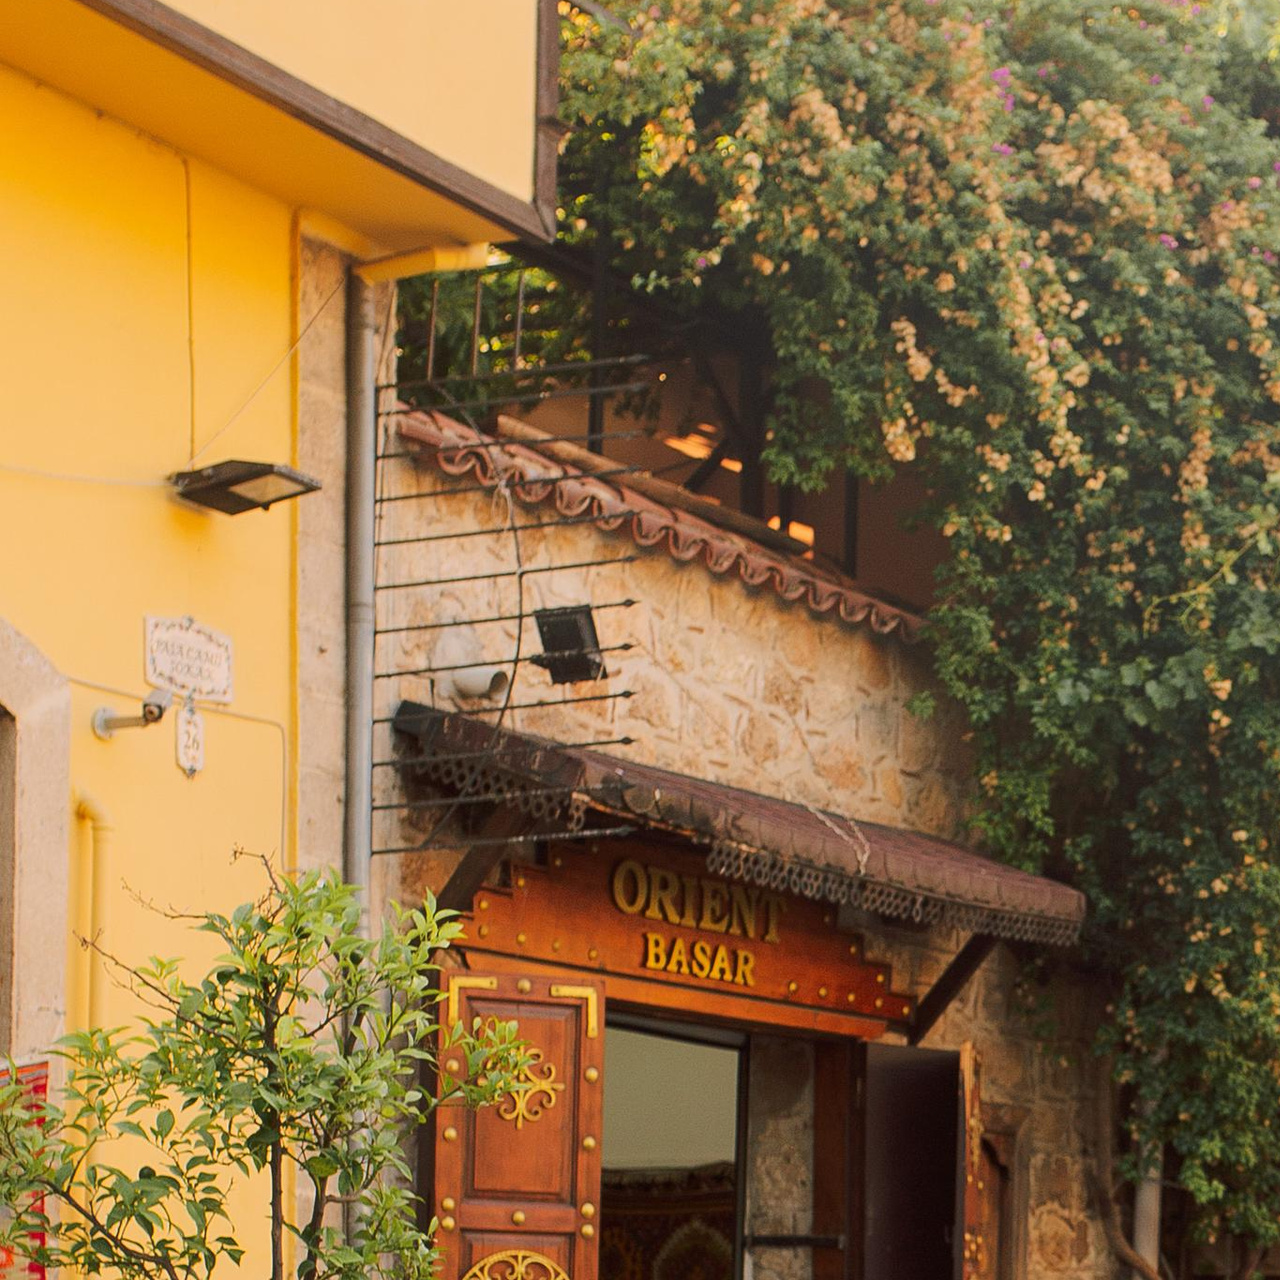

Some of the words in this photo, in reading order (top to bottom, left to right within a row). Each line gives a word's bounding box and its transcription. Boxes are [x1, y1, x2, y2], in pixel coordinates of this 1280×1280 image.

[183, 730, 200, 752] 26
[613, 859, 787, 943] ORIENT
[645, 932, 756, 986] BASAR
